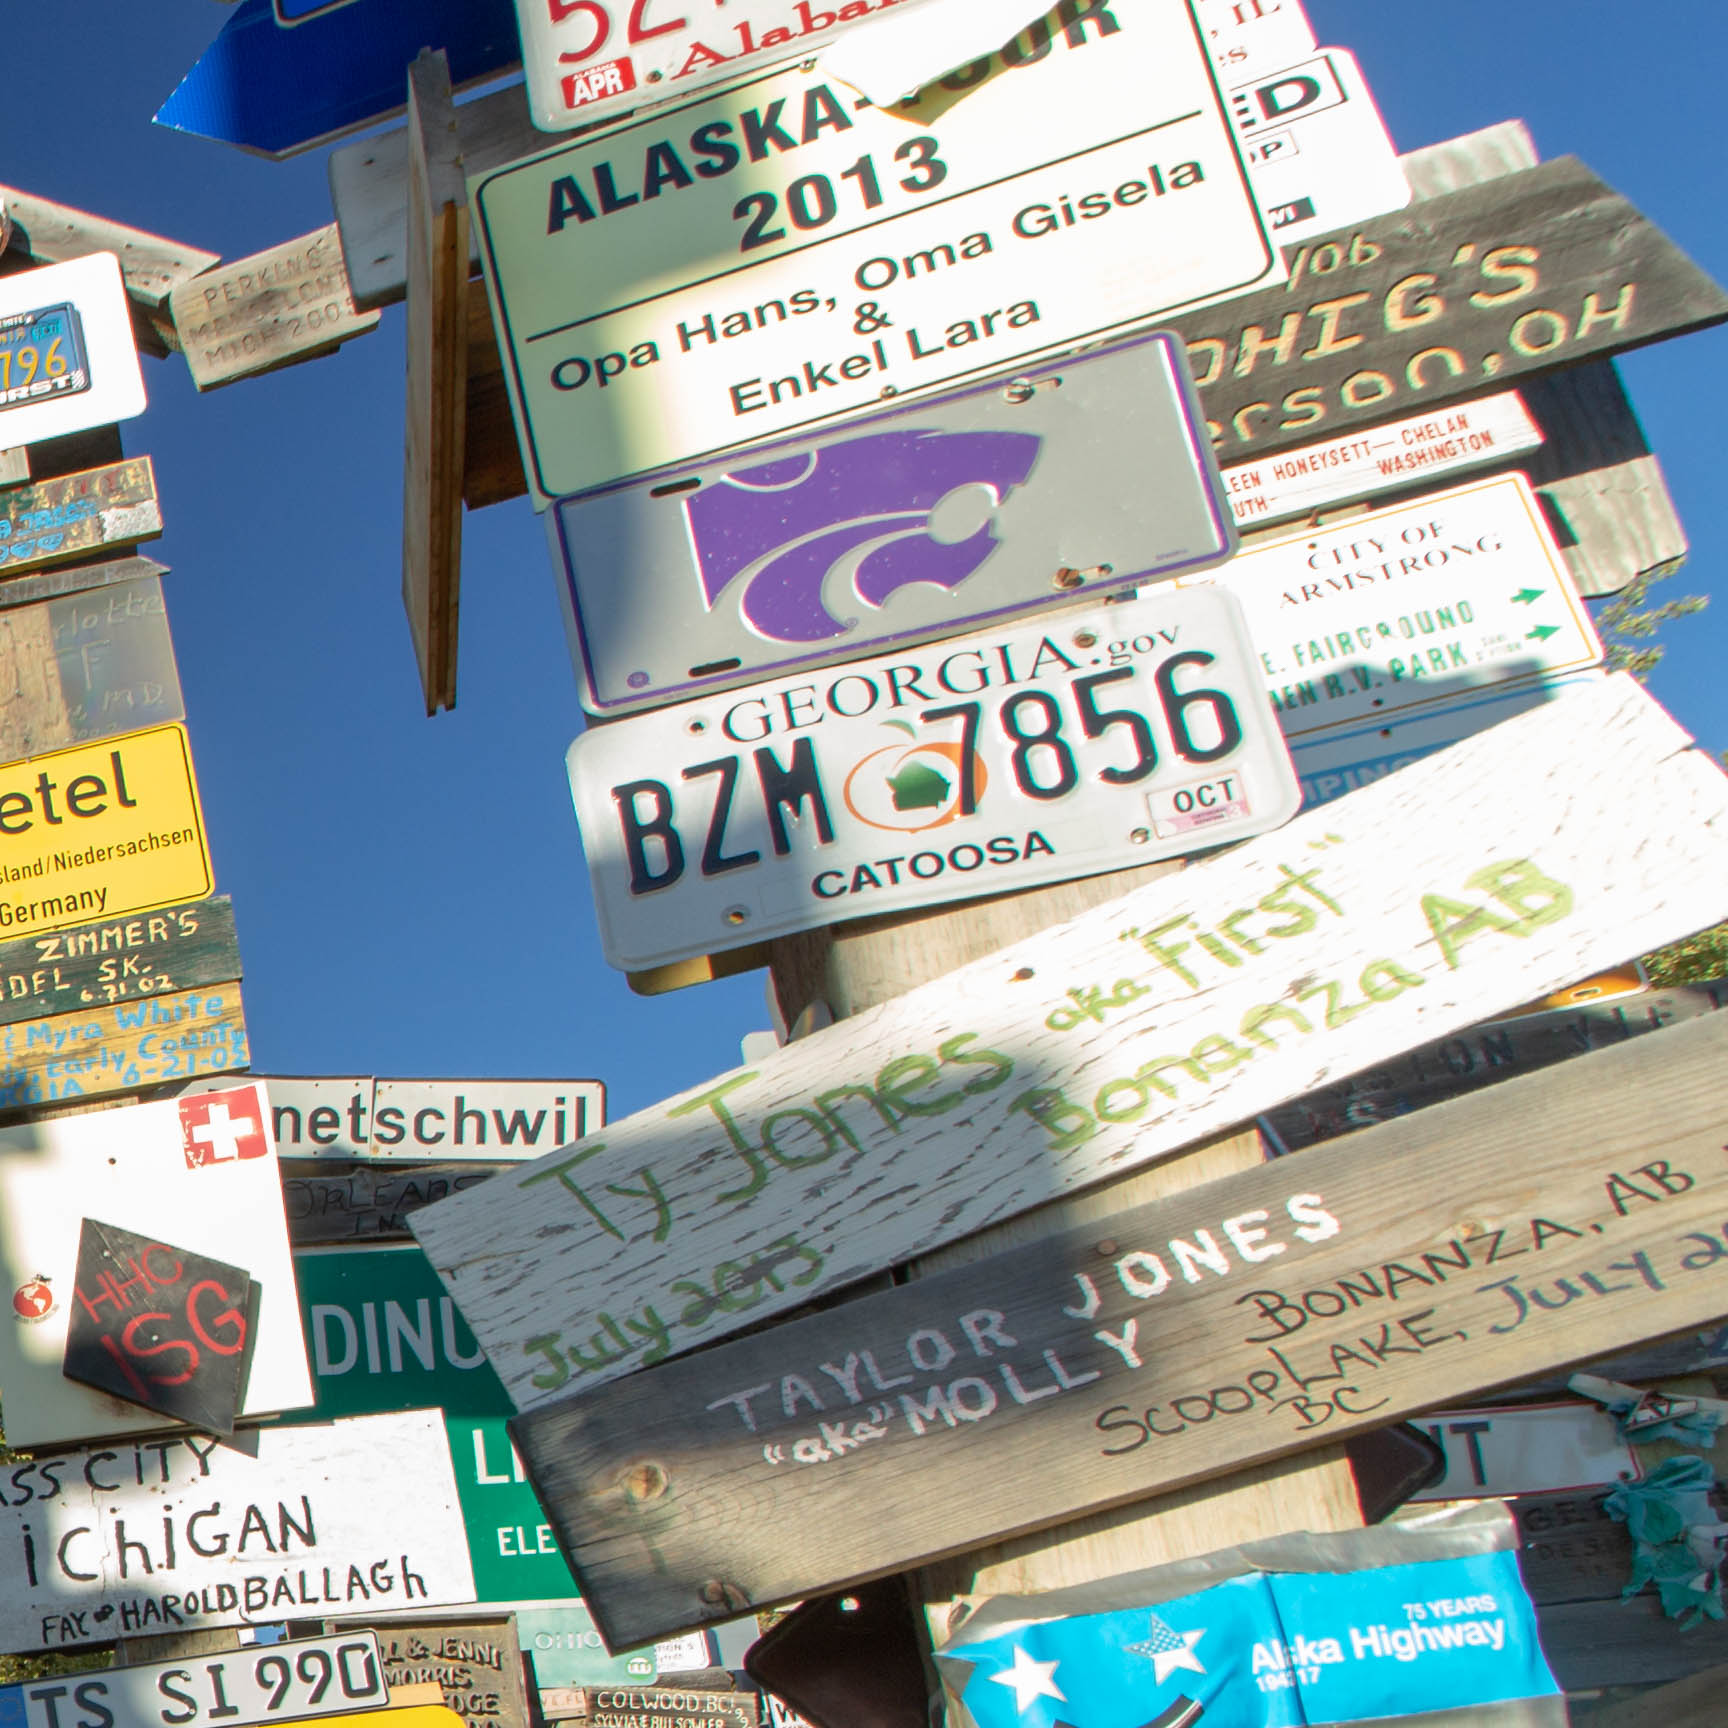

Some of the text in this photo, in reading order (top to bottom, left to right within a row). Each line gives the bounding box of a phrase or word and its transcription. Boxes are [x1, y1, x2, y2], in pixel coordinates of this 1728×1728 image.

[572, 66, 625, 107] APR
[731, 134, 950, 253] 2013
[549, 153, 1208, 395] Opa Hans, Oma Gisela
[728, 295, 1042, 418] Enkel Lara
[1280, 533, 1504, 610] ARMSTRONG
[1307, 520, 1445, 570] CITY OF
[609, 651, 1242, 896] BZM 7856
[1172, 778, 1235, 813] OCT
[811, 831, 1056, 899] CATOOSA
[35, 911, 200, 963] ZIMMER'S
[1234, 1158, 1695, 1344] BONANZA, AB
[1352, 1618, 1505, 1664] Highway
[160, 1663, 239, 1724] SI
[255, 1641, 373, 1710] 990
